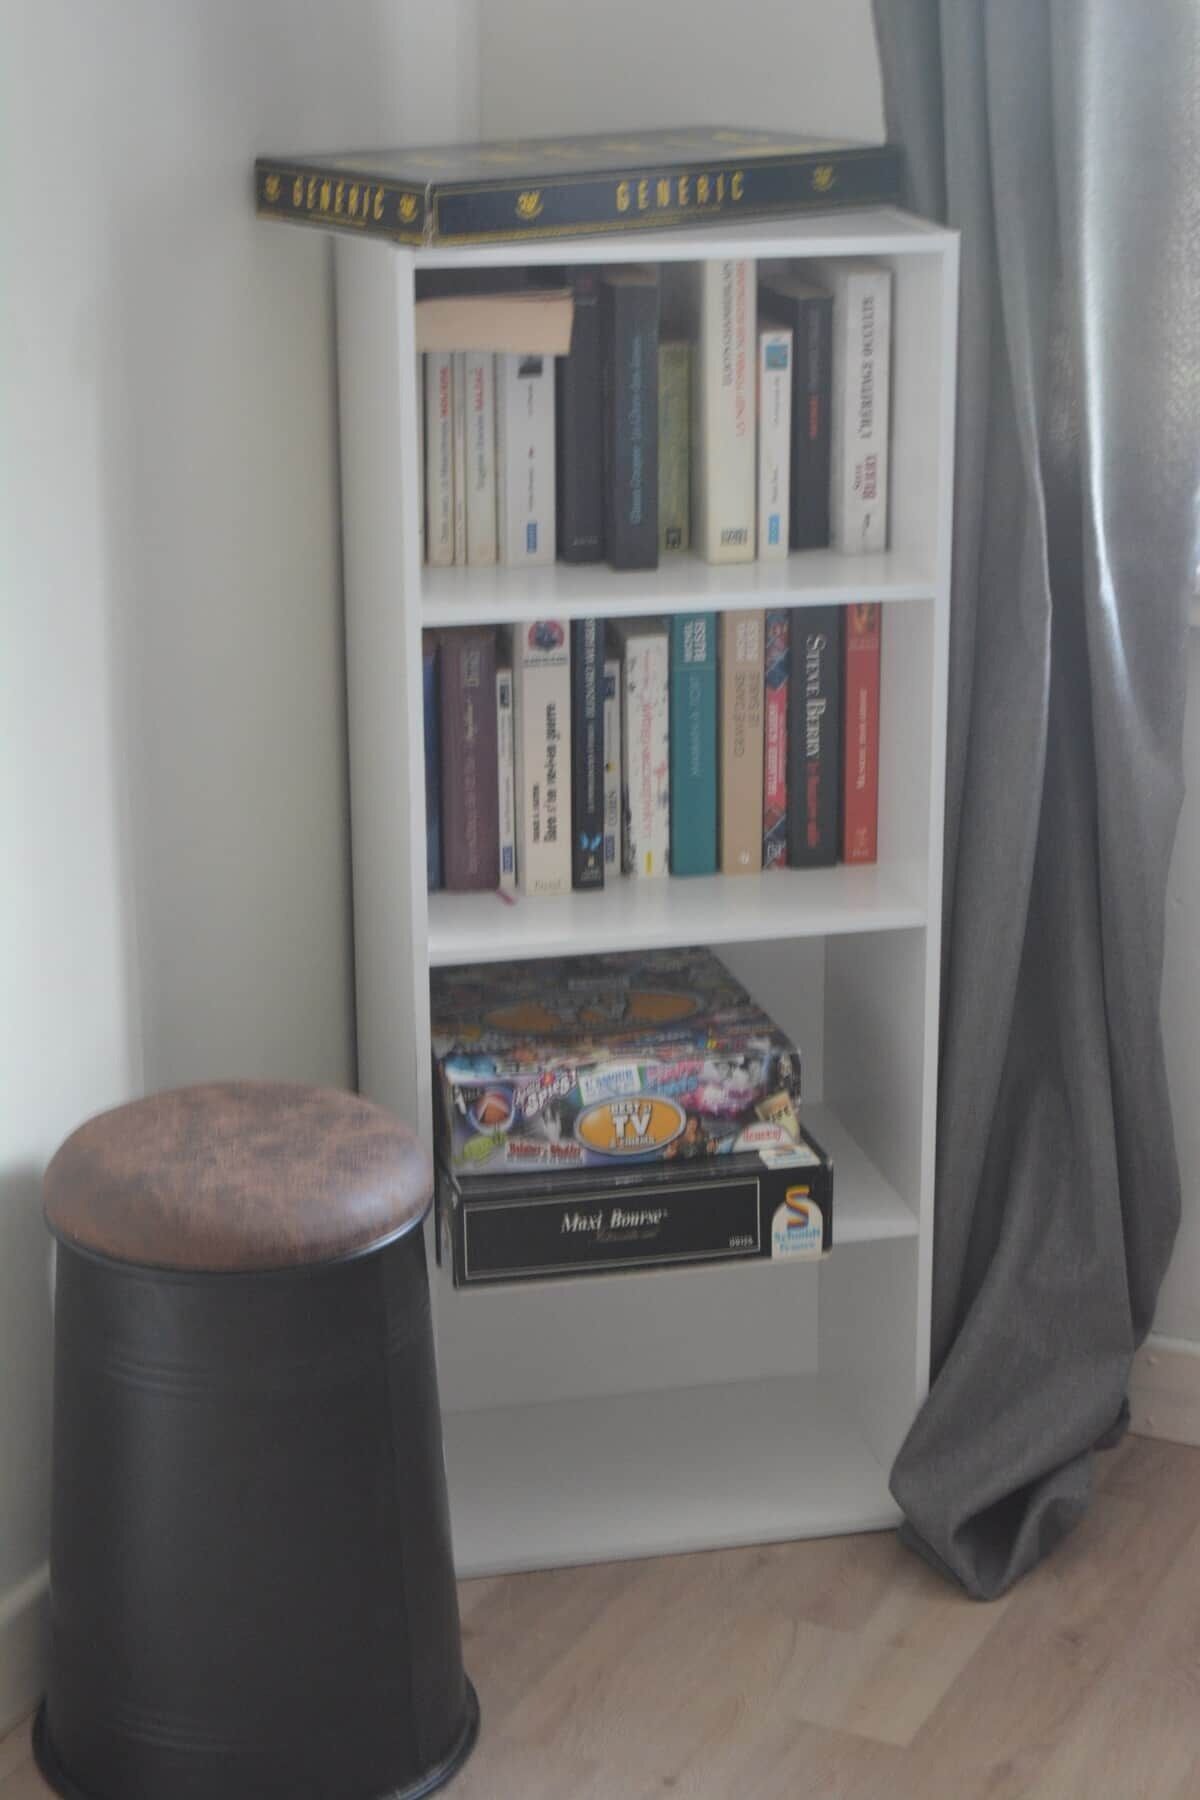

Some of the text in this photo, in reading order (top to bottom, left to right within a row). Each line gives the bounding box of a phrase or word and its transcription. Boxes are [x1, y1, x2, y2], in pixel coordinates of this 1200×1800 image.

[292, 174, 386, 221] GENERIC
[616, 170, 745, 212] GENERIC
[805, 633, 826, 696] STEVE
[805, 697, 827, 758] BERRY
[611, 1114, 652, 1138] TV
[561, 1211, 602, 1234] Maxi
[610, 1207, 662, 1229] Bourse
